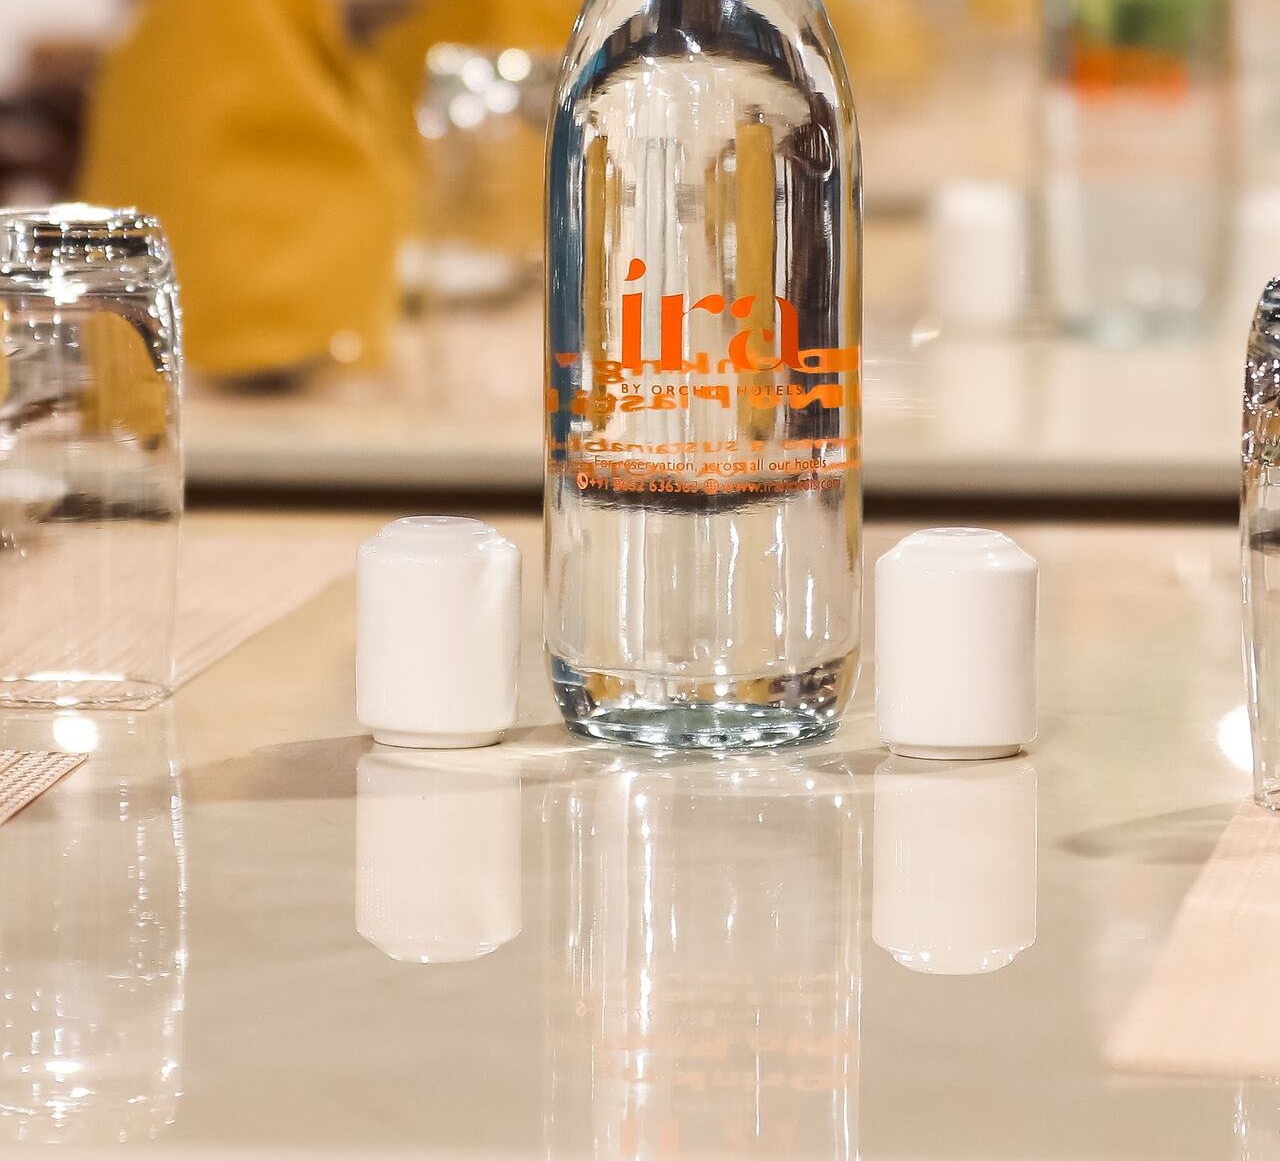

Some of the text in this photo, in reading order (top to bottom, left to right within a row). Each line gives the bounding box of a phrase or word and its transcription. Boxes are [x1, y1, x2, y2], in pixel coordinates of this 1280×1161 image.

[621, 257, 804, 371] ira
[621, 383, 642, 395] BY
[737, 385, 803, 396] HOTELS
[594, 455, 827, 472] For reservation, across all our hotels
